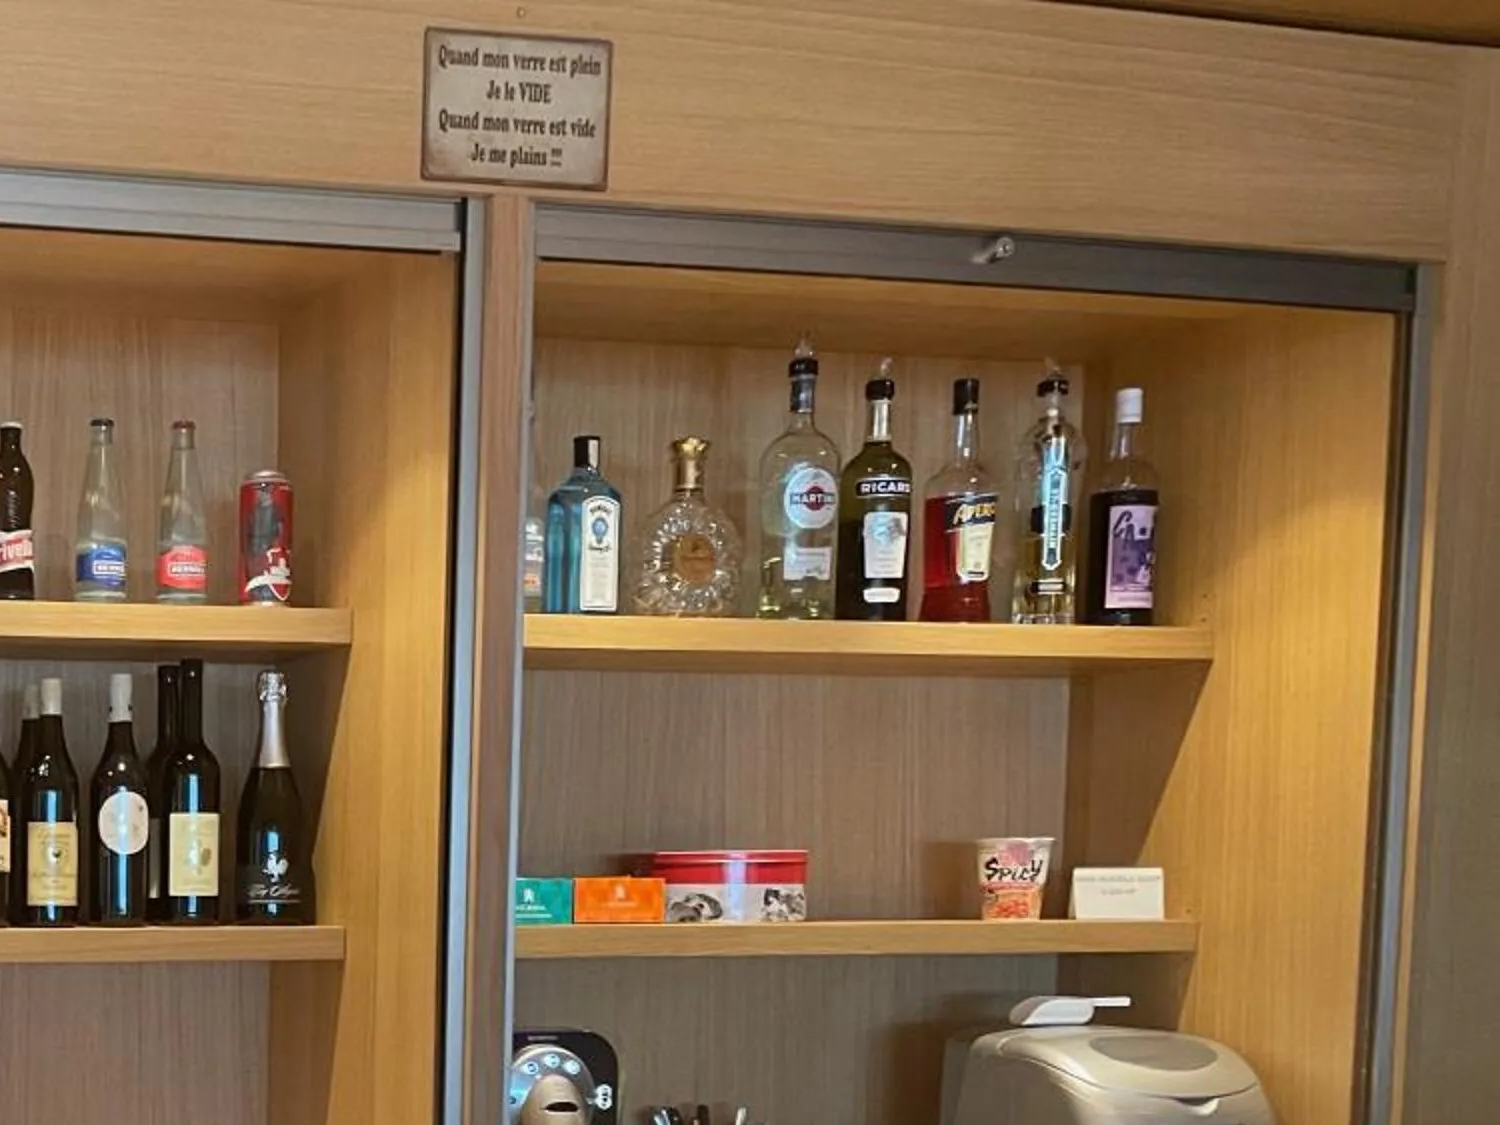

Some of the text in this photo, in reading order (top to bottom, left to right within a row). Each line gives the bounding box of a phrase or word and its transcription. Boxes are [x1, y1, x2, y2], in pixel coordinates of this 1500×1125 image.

[439, 45, 602, 78] Quand mon verre est plein
[486, 80, 552, 104] Je le VIDE
[439, 108, 596, 138] Quand mon verre est vide
[471, 143, 485, 162] Je
[490, 149, 507, 163] me
[510, 146, 547, 169] plains
